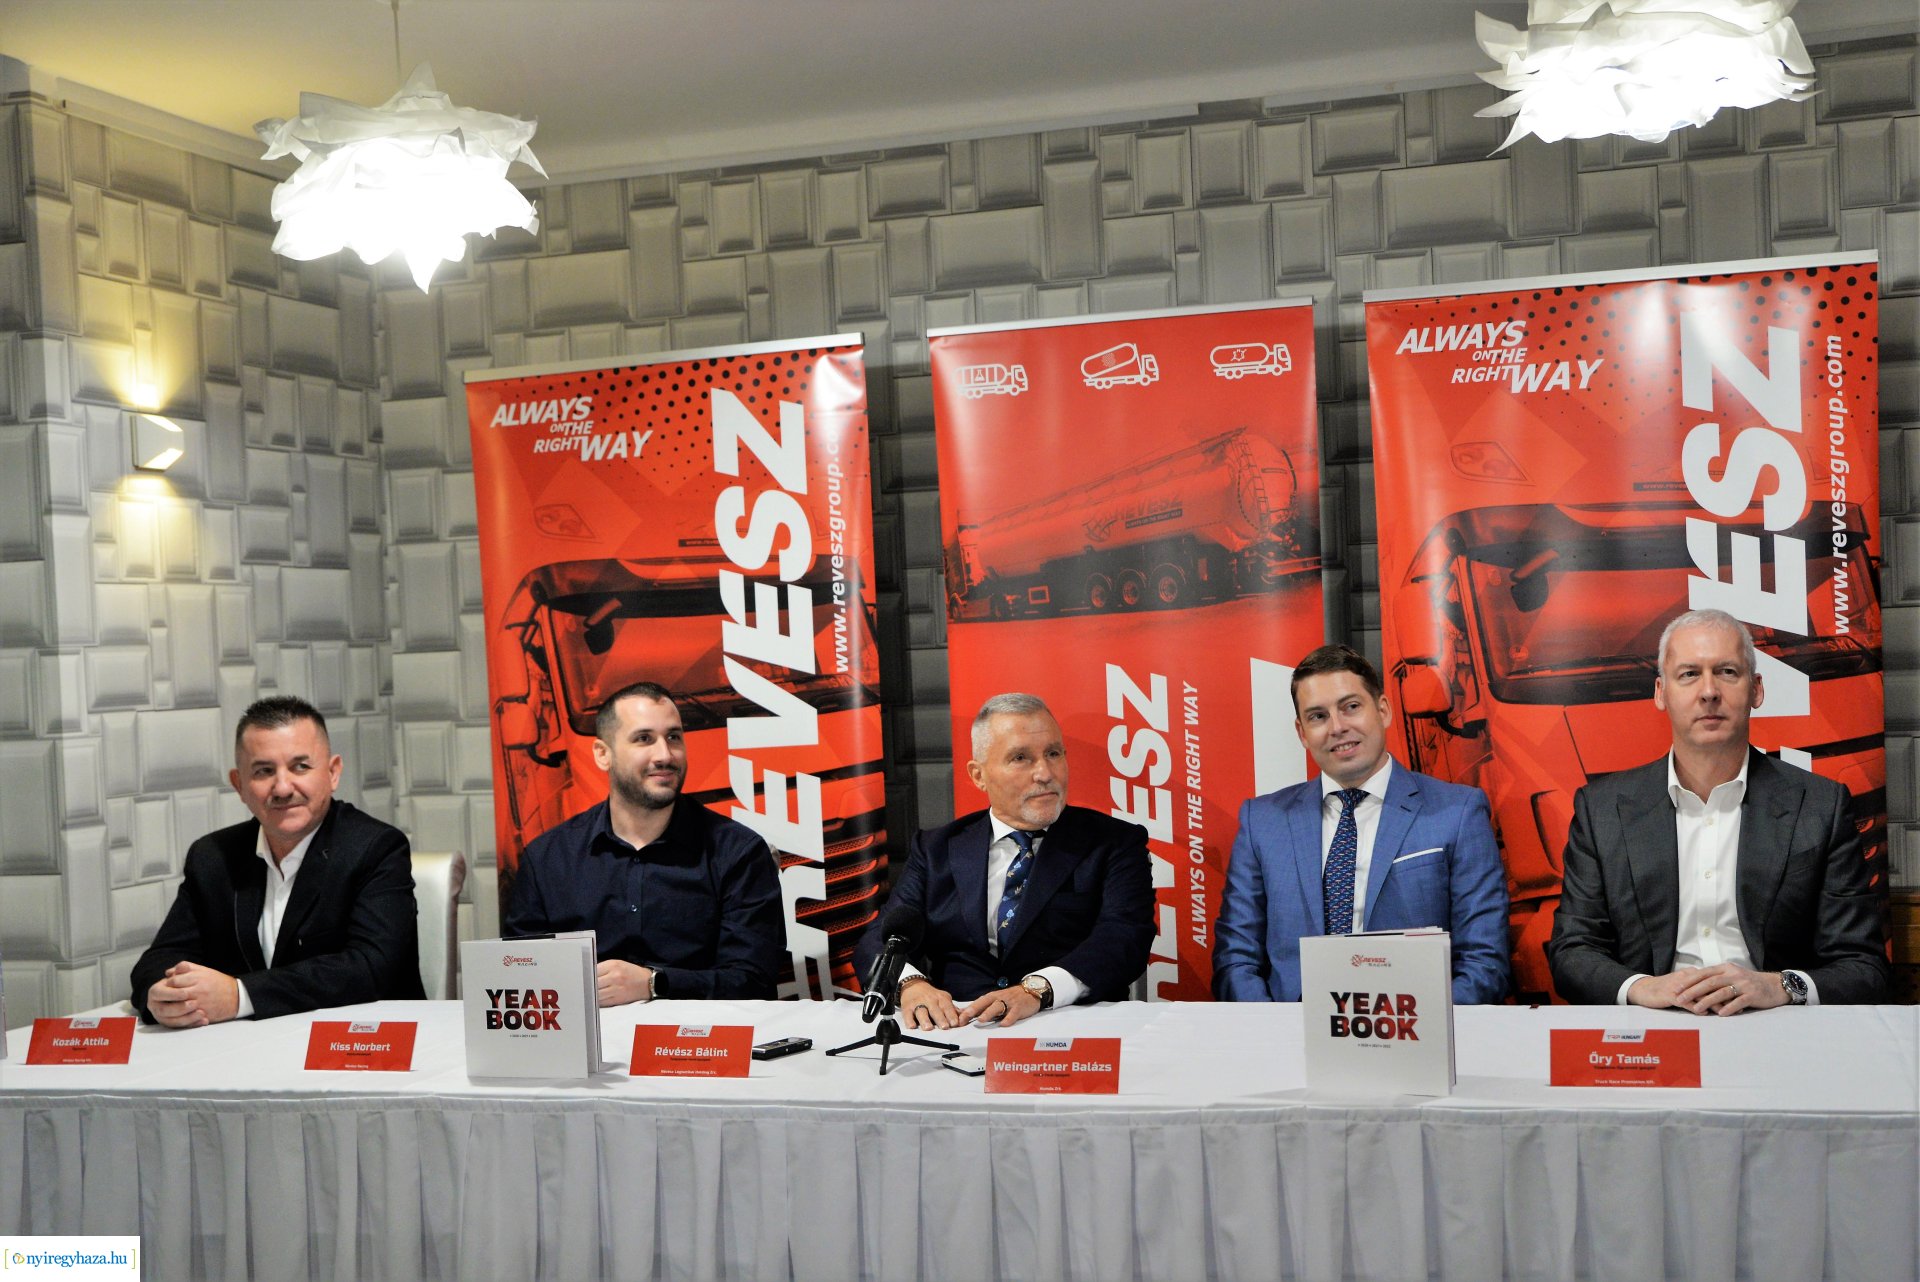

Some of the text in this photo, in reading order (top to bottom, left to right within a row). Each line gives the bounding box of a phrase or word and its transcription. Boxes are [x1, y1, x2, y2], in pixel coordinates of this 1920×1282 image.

[1396, 320, 1526, 355] ALWAYS
[1472, 347, 1528, 365] ON THE
[1451, 359, 1604, 394] RIGHT WAY
[490, 396, 593, 428] ALWAYS
[549, 420, 595, 436] ON THE
[533, 430, 654, 462] RIGHT WAY
[1826, 335, 1850, 635] www.reveszgroup.com
[826, 428, 850, 673] www.reveszgroup.co
[1182, 680, 1207, 948] ALWAYS ON THE RIGHT WAY
[485, 988, 560, 1010] YEAR
[1329, 991, 1420, 1017] YEAR
[485, 1009, 562, 1031] BOOK
[1330, 1015, 1420, 1041] BOOK
[52, 1037, 110, 1047] Kozák Attila
[329, 1042, 391, 1052] Kiss Norbert
[654, 1046, 729, 1057] Révész Bálint
[993, 1060, 1113, 1073] Weingartner Balázs
[1588, 1051, 1661, 1066] Őry Tamás
